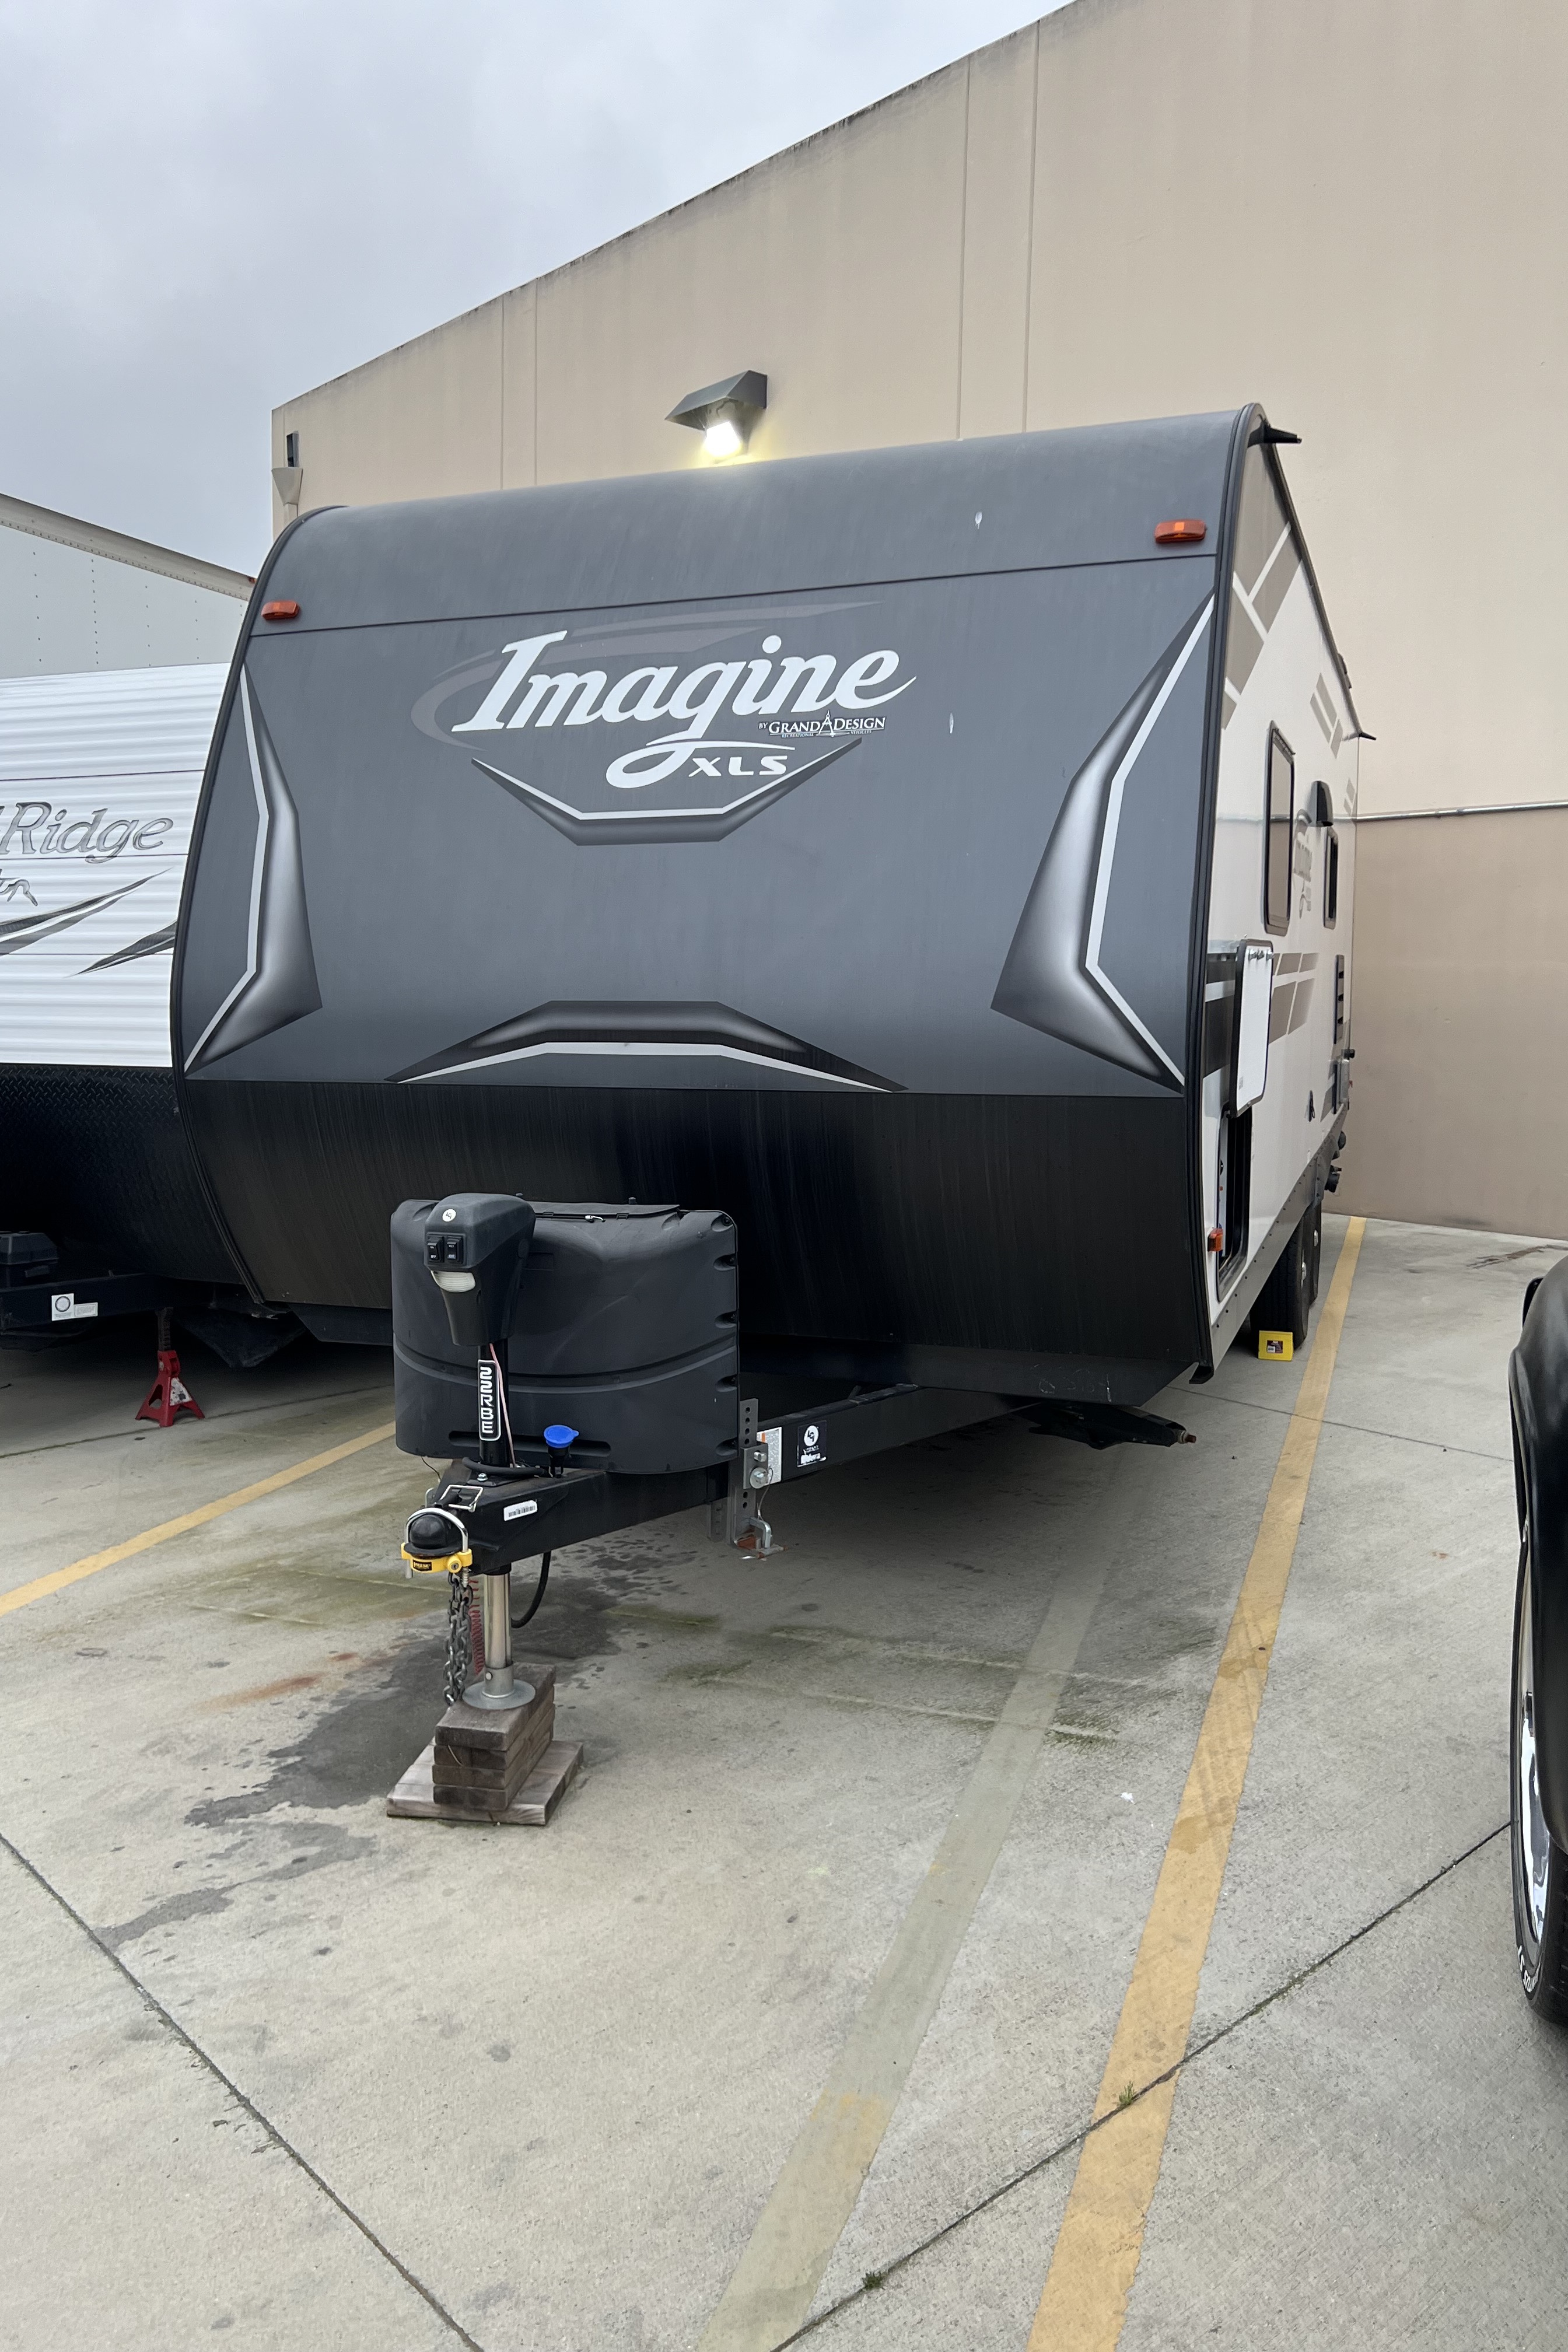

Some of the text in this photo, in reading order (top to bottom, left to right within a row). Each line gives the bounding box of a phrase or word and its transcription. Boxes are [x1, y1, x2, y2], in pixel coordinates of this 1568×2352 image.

[452, 630, 916, 789] Imagine
[769, 720, 821, 734] GRAND
[834, 717, 886, 730] DESIGN
[688, 755, 788, 778] XLS
[0, 802, 173, 864] Ridge
[480, 1366, 494, 1433] 22RBE
